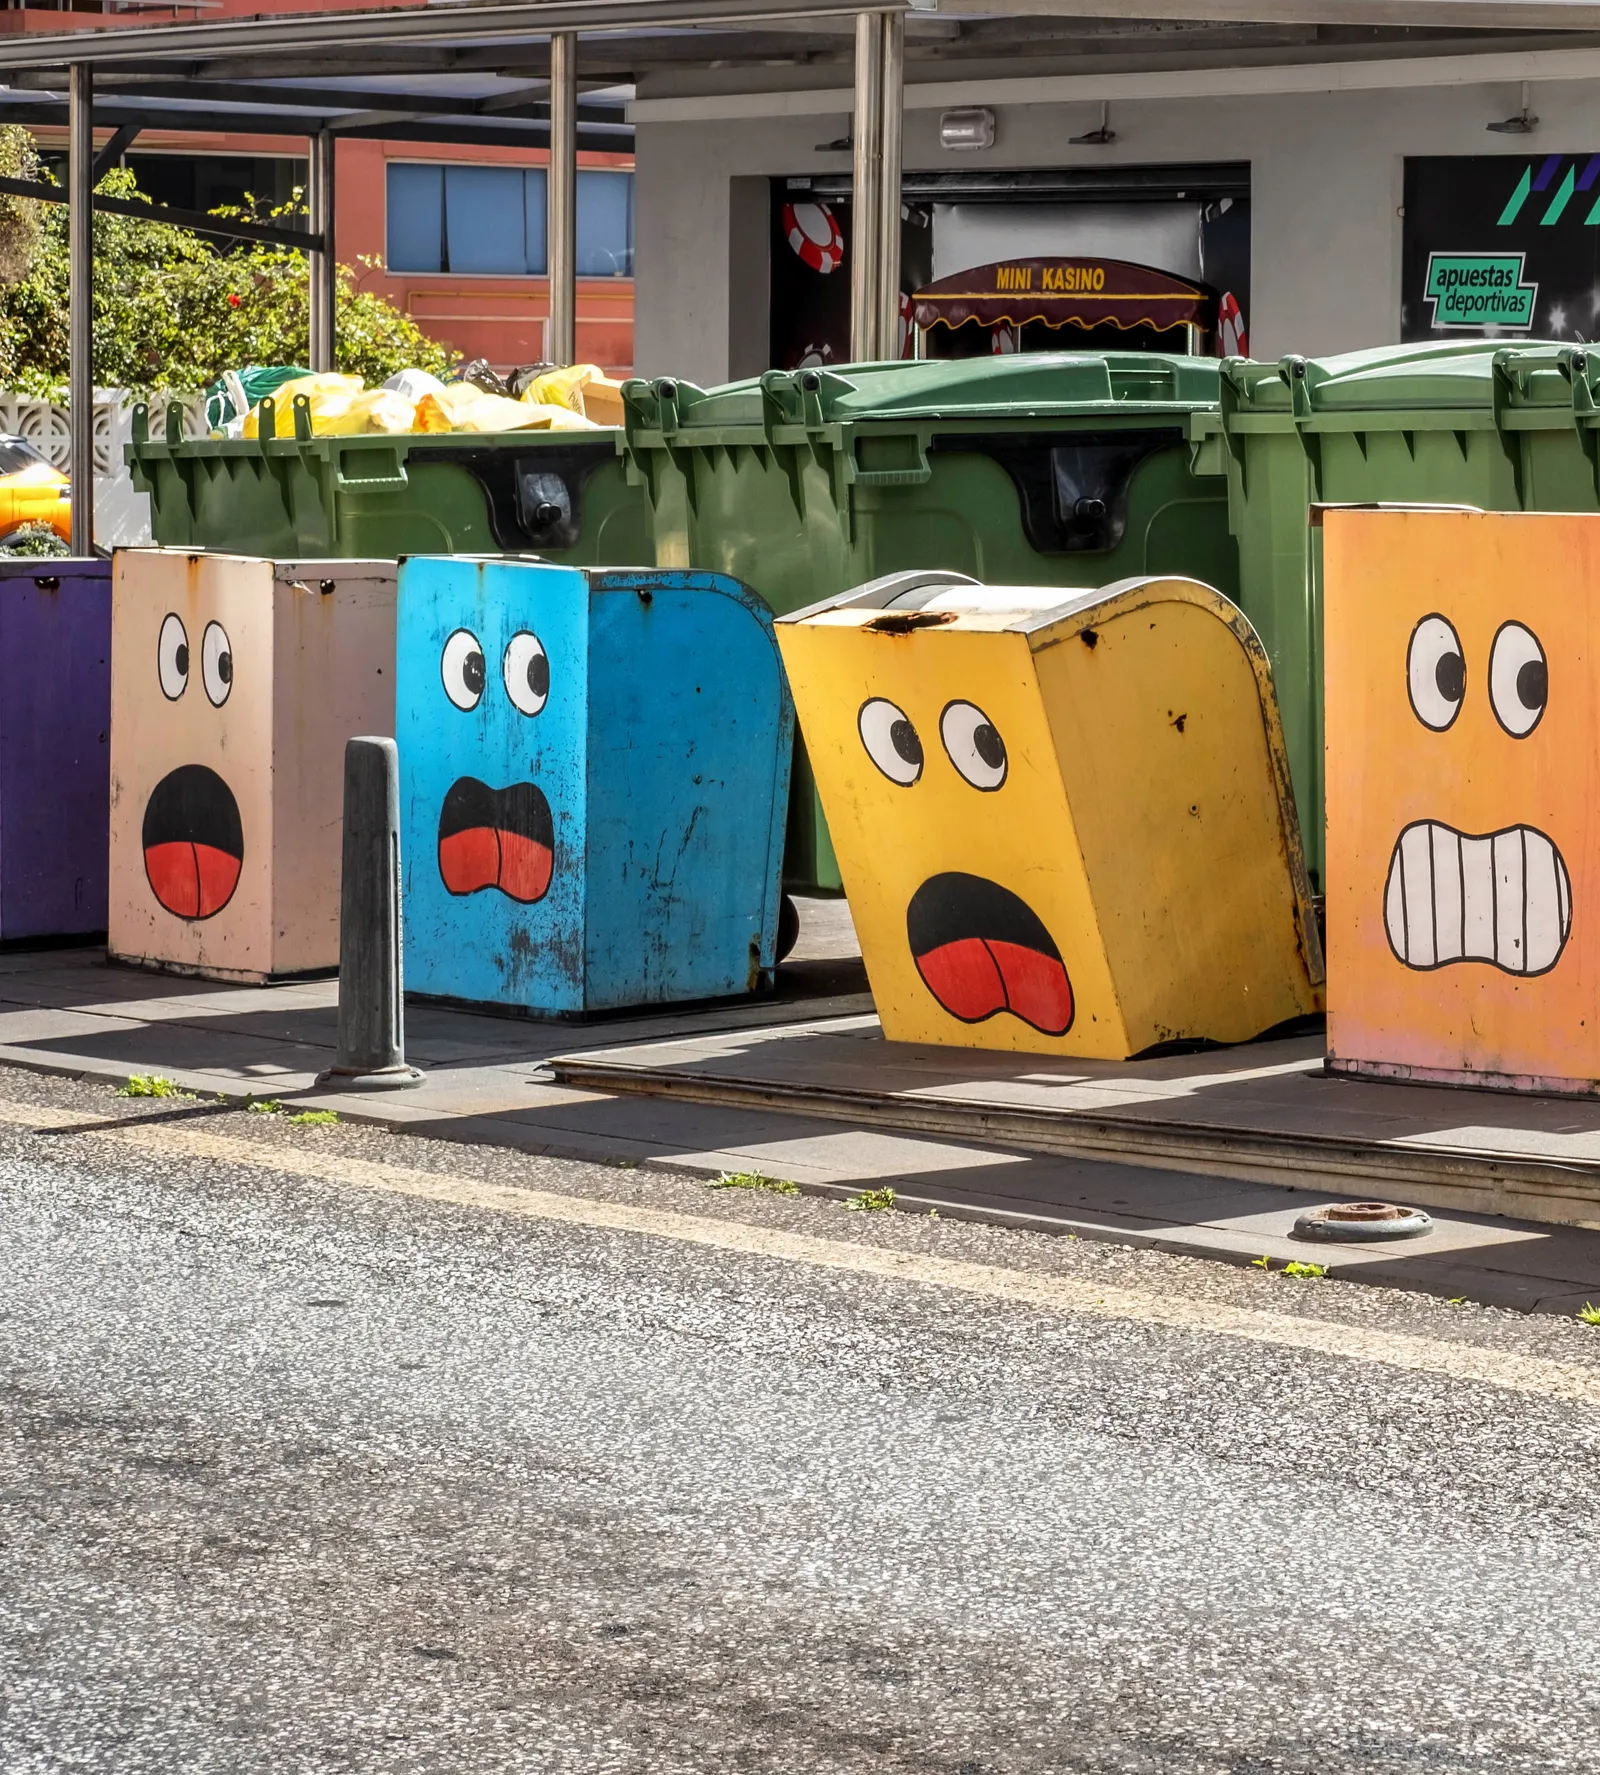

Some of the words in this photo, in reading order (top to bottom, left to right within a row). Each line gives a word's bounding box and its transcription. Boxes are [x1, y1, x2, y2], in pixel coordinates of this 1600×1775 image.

[996, 267, 1032, 290] MINI
[1042, 267, 1105, 291] KASINO
[1436, 264, 1514, 293] apuestas
[1445, 288, 1526, 317] deportivas
